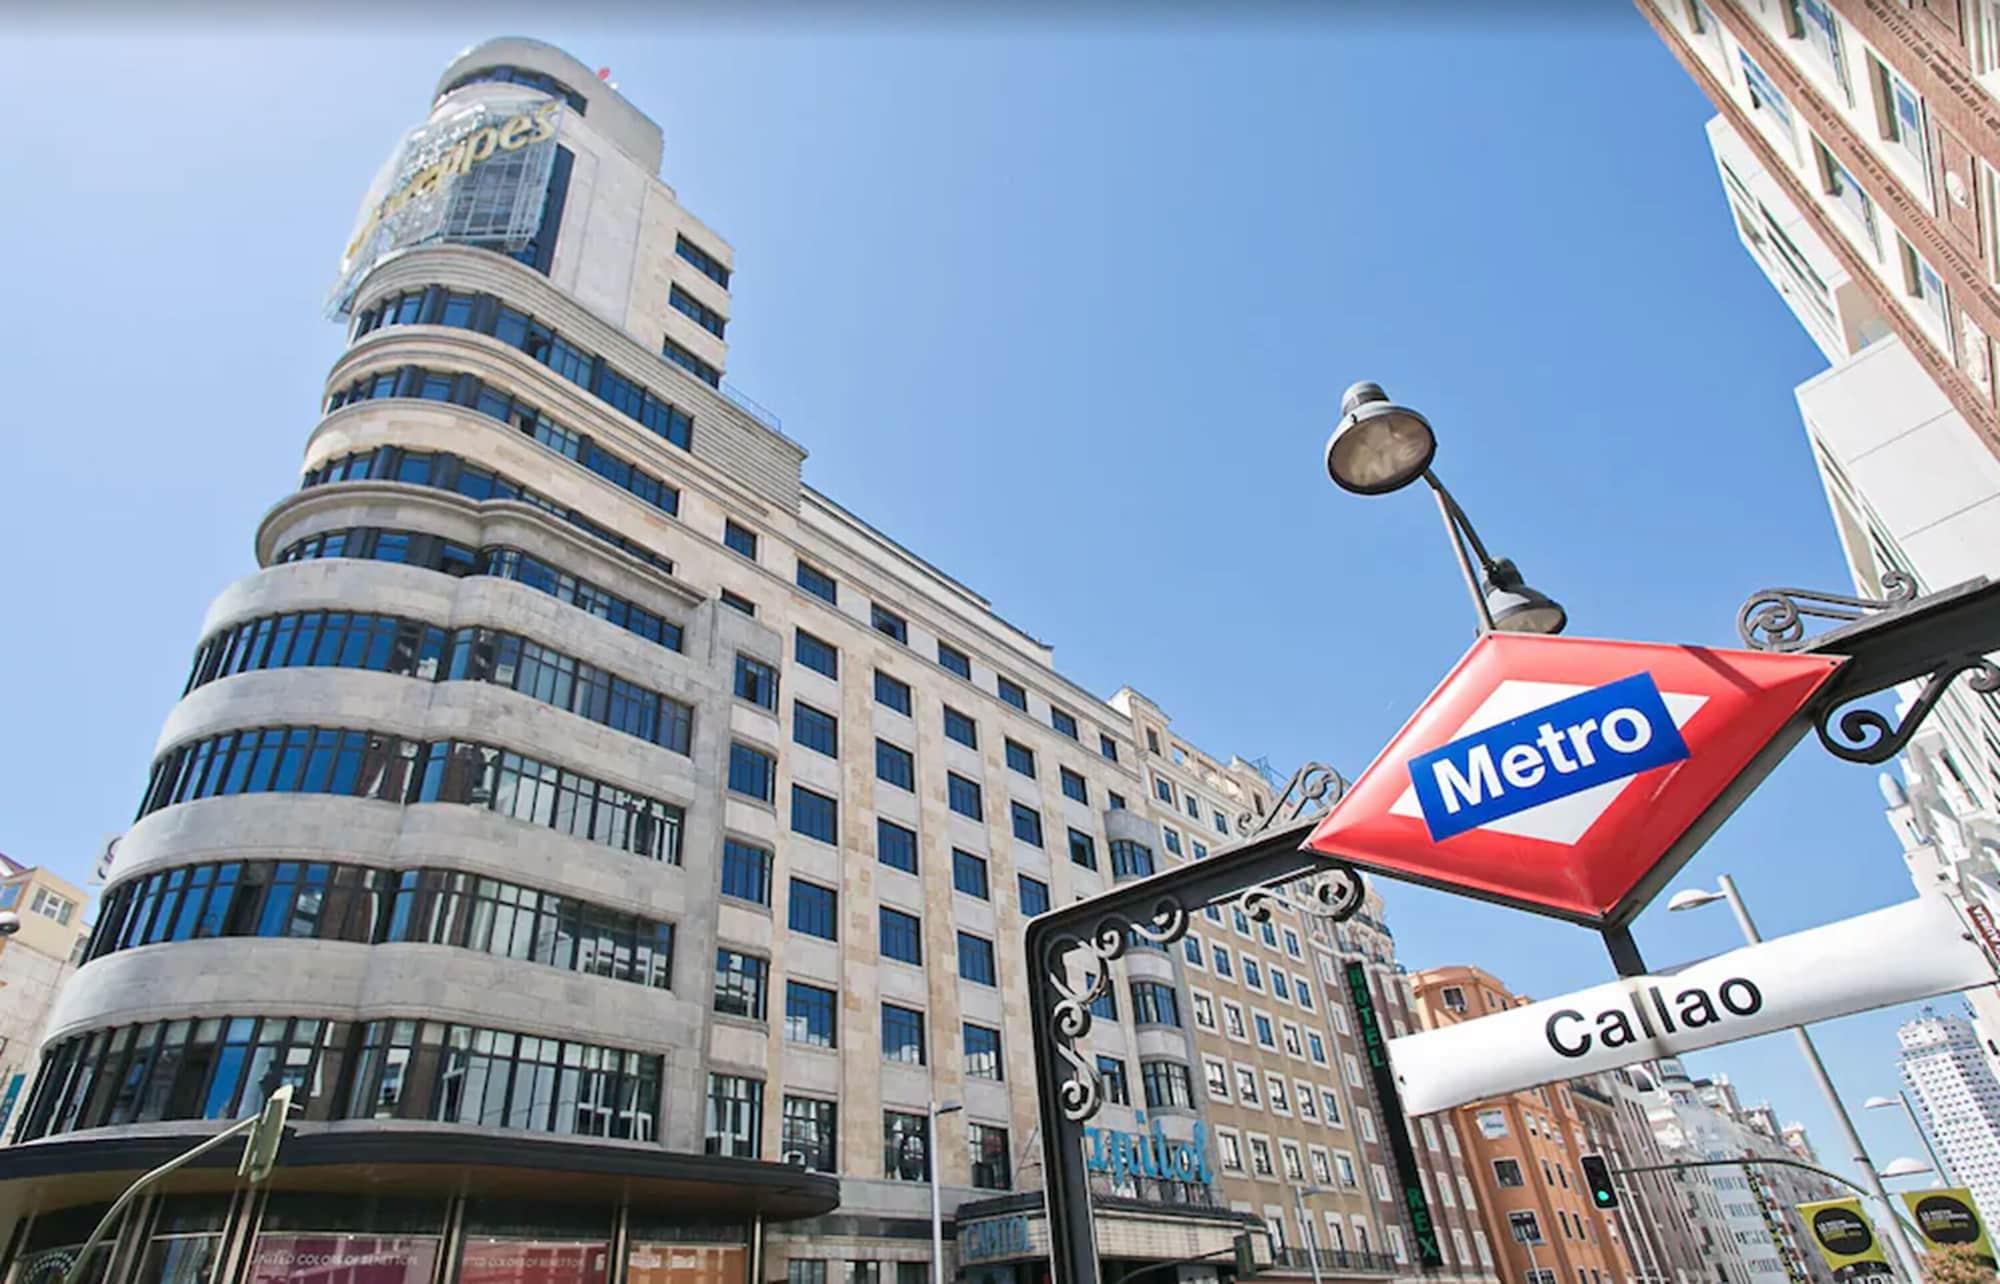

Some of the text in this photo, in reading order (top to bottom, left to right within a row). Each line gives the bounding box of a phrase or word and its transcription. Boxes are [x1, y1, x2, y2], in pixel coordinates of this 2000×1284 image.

[1432, 707, 1652, 814] Metro
[1545, 977, 1763, 1058] Callao
[1348, 966, 1439, 1257] HOTEL REX
[296, 1254, 342, 1265] COLORS
